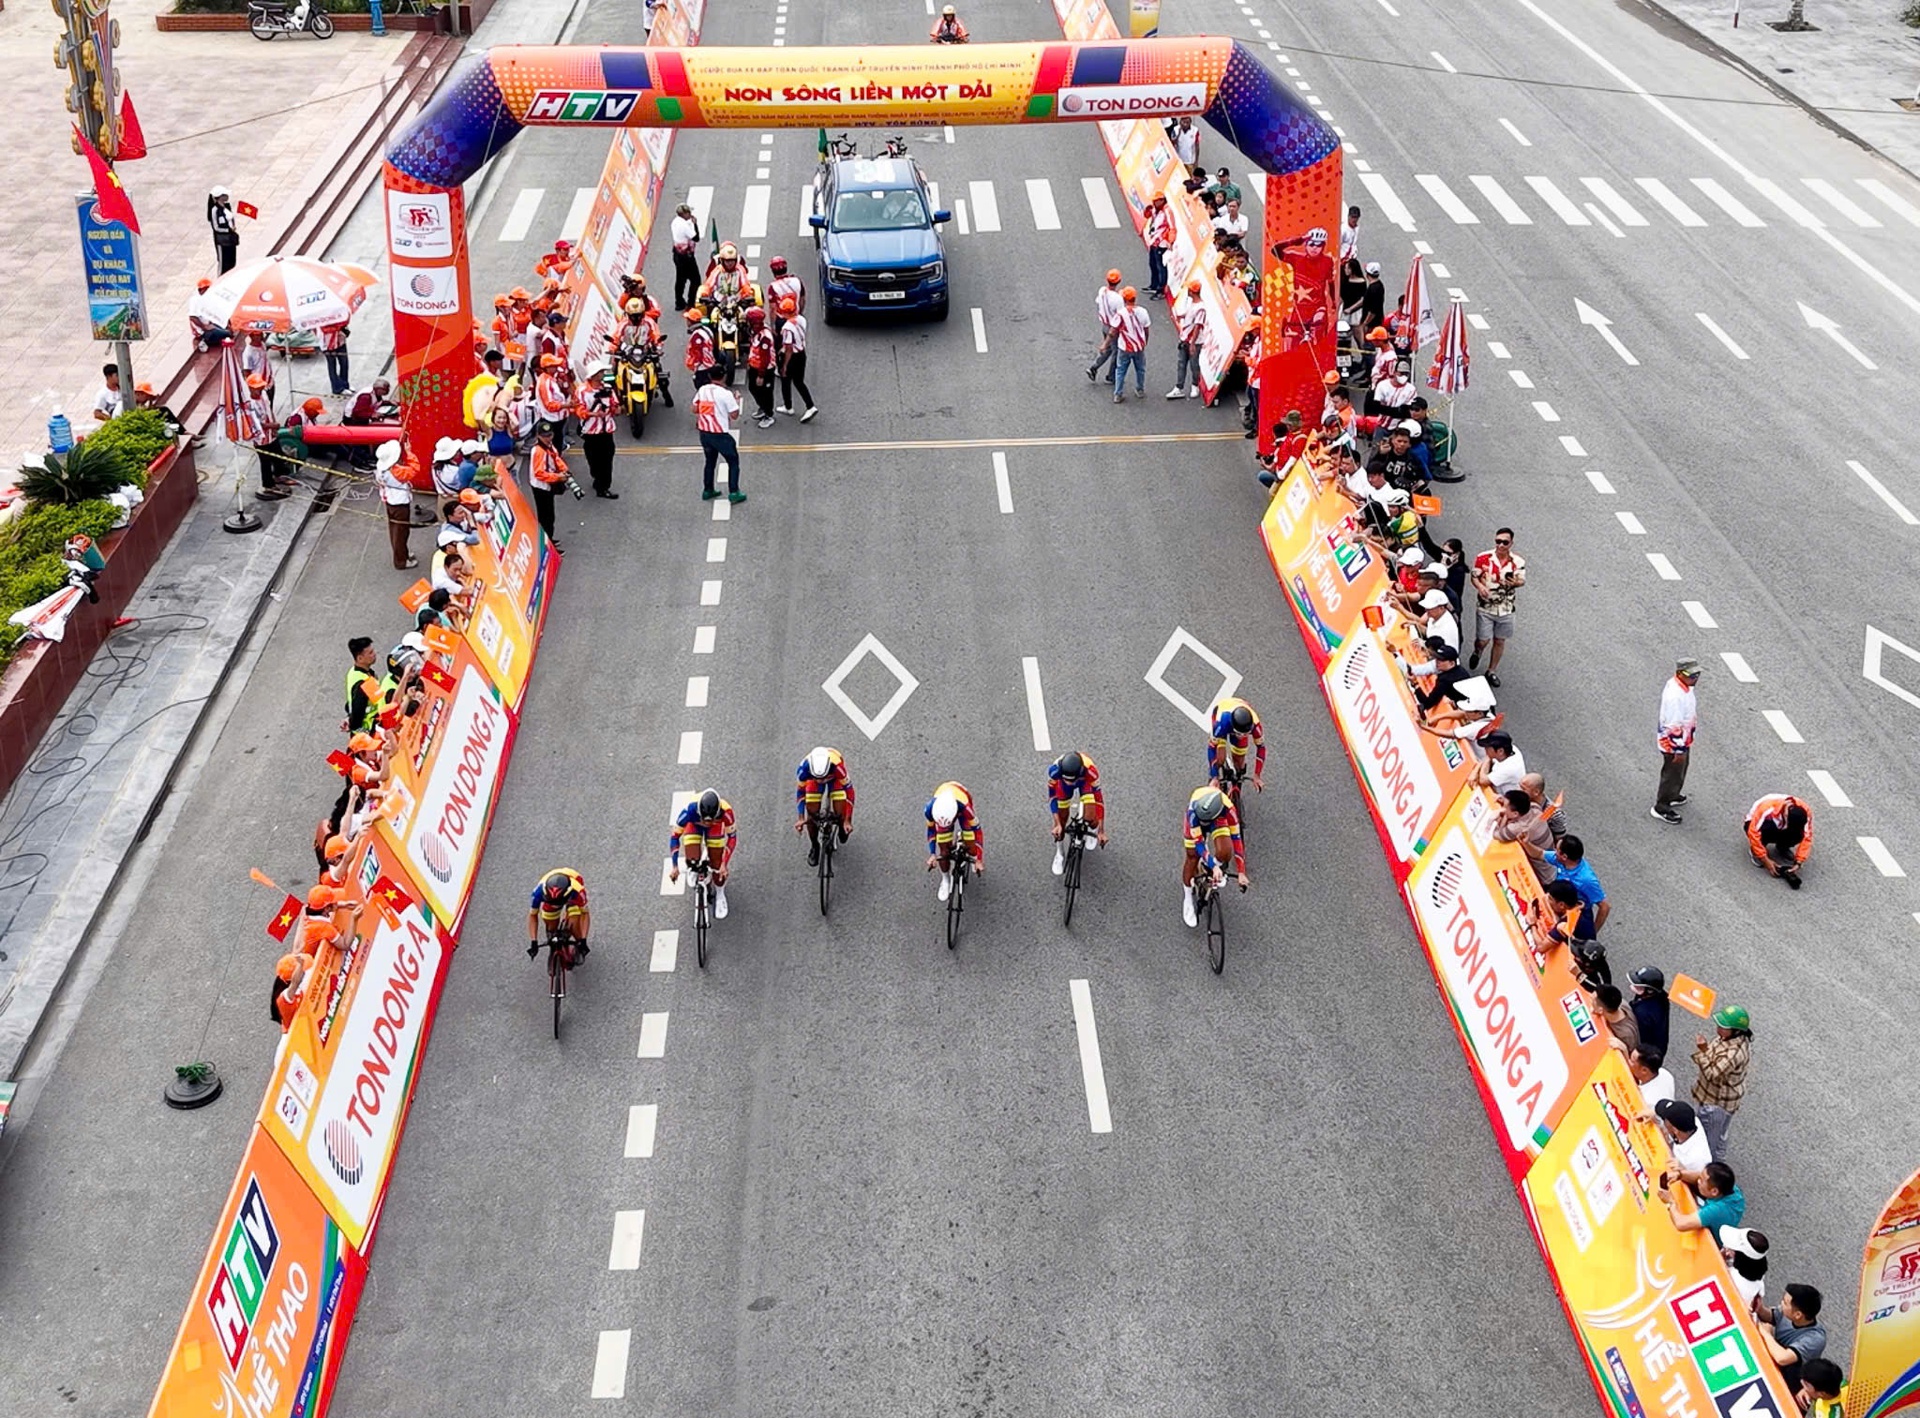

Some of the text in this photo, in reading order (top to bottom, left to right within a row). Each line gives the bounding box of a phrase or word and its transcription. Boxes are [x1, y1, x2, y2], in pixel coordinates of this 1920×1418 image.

[526, 91, 640, 121] HTV
[725, 79, 992, 103] NON SÔNG LIỀN MỘT DẢI
[1086, 95, 1200, 112] TON DONG A
[396, 297, 456, 310] TON DONG A
[438, 694, 499, 850] TON DONG A
[1354, 676, 1385, 743] TON
[1373, 727, 1415, 816] DONG
[1402, 805, 1423, 841] A
[346, 920, 430, 1137] TON DONG A
[1447, 896, 1543, 1126] TON DONG A
[1562, 990, 1596, 1041] HTV
[207, 1180, 278, 1373] HTV
[265, 1261, 309, 1367] THAO
[1865, 1305, 1896, 1324] HTV
